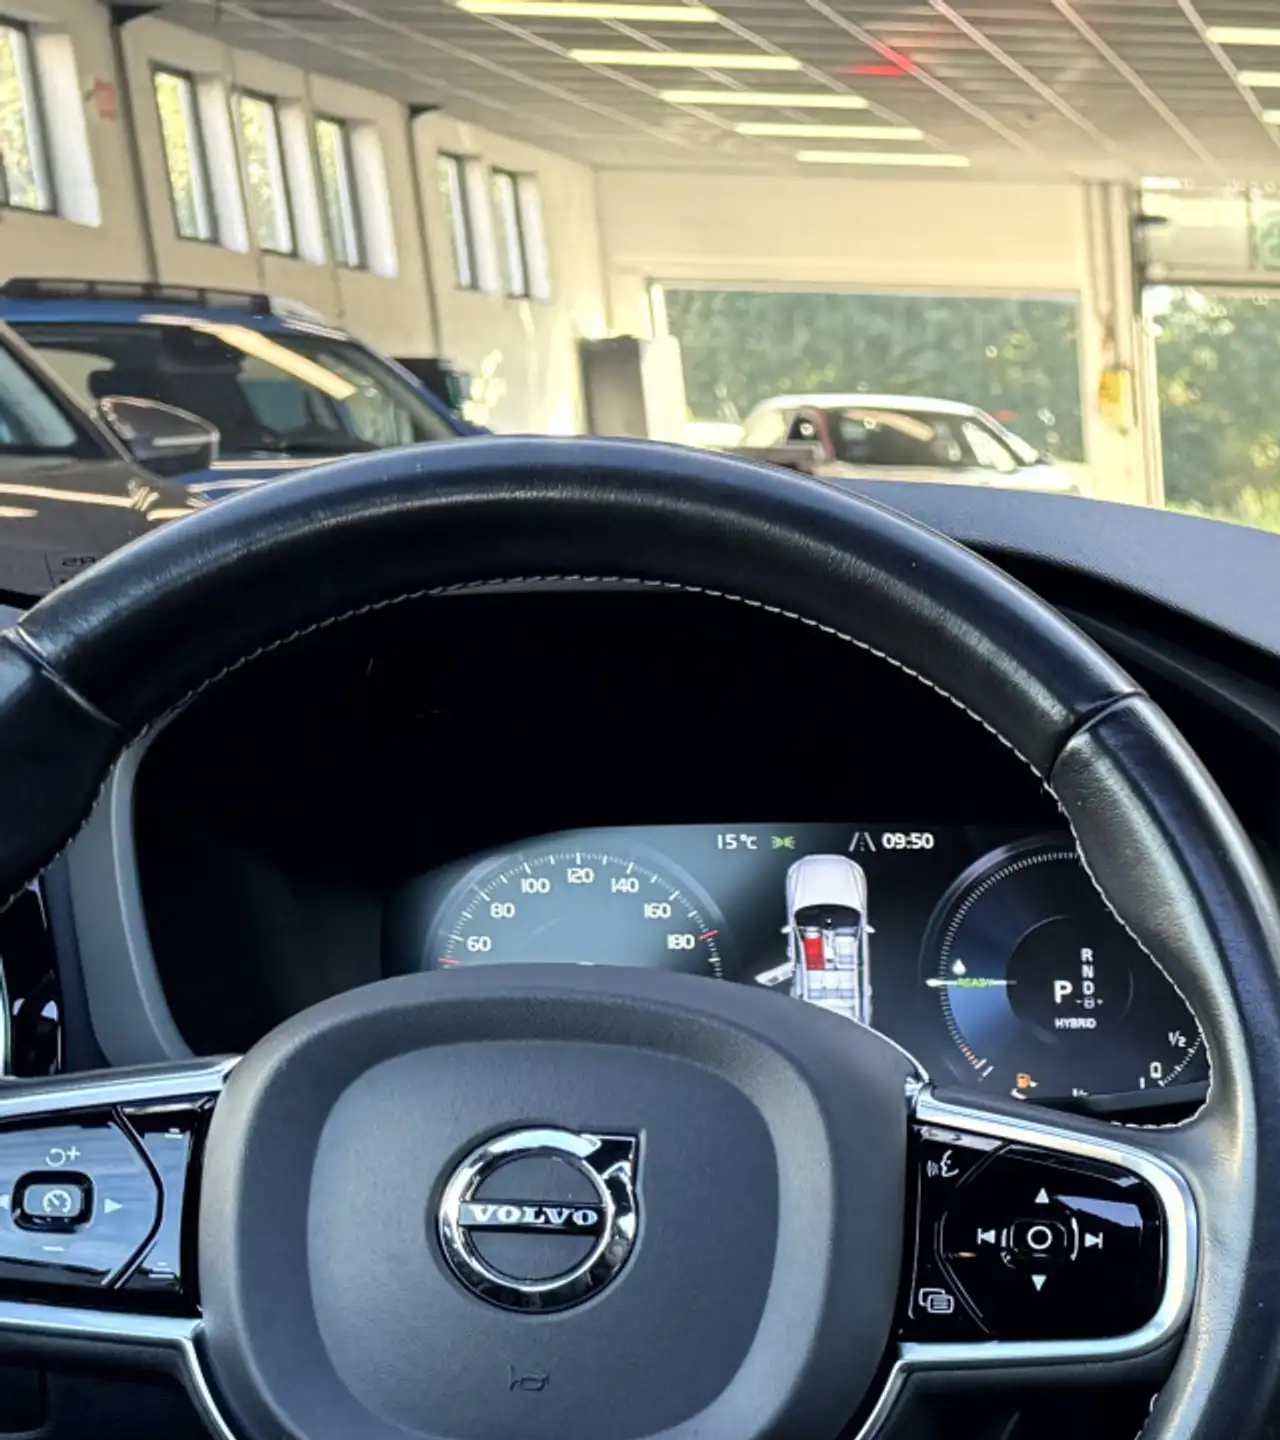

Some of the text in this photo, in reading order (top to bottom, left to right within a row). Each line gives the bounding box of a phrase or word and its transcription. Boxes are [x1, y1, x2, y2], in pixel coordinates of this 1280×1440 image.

[882, 832, 935, 850] 09:50
[567, 867, 595, 884] 120
[521, 877, 551, 894] 100
[611, 877, 639, 894] 140
[490, 902, 516, 919] 80
[643, 902, 672, 919] 160
[466, 936, 492, 952] 60
[666, 933, 696, 951] 180
[1081, 947, 1094, 963] R
[1082, 964, 1095, 979] N
[1053, 980, 1073, 1004] P
[1082, 980, 1096, 995] D
[1054, 1016, 1098, 1030] HYBRID
[468, 1203, 599, 1226] VOLVO
